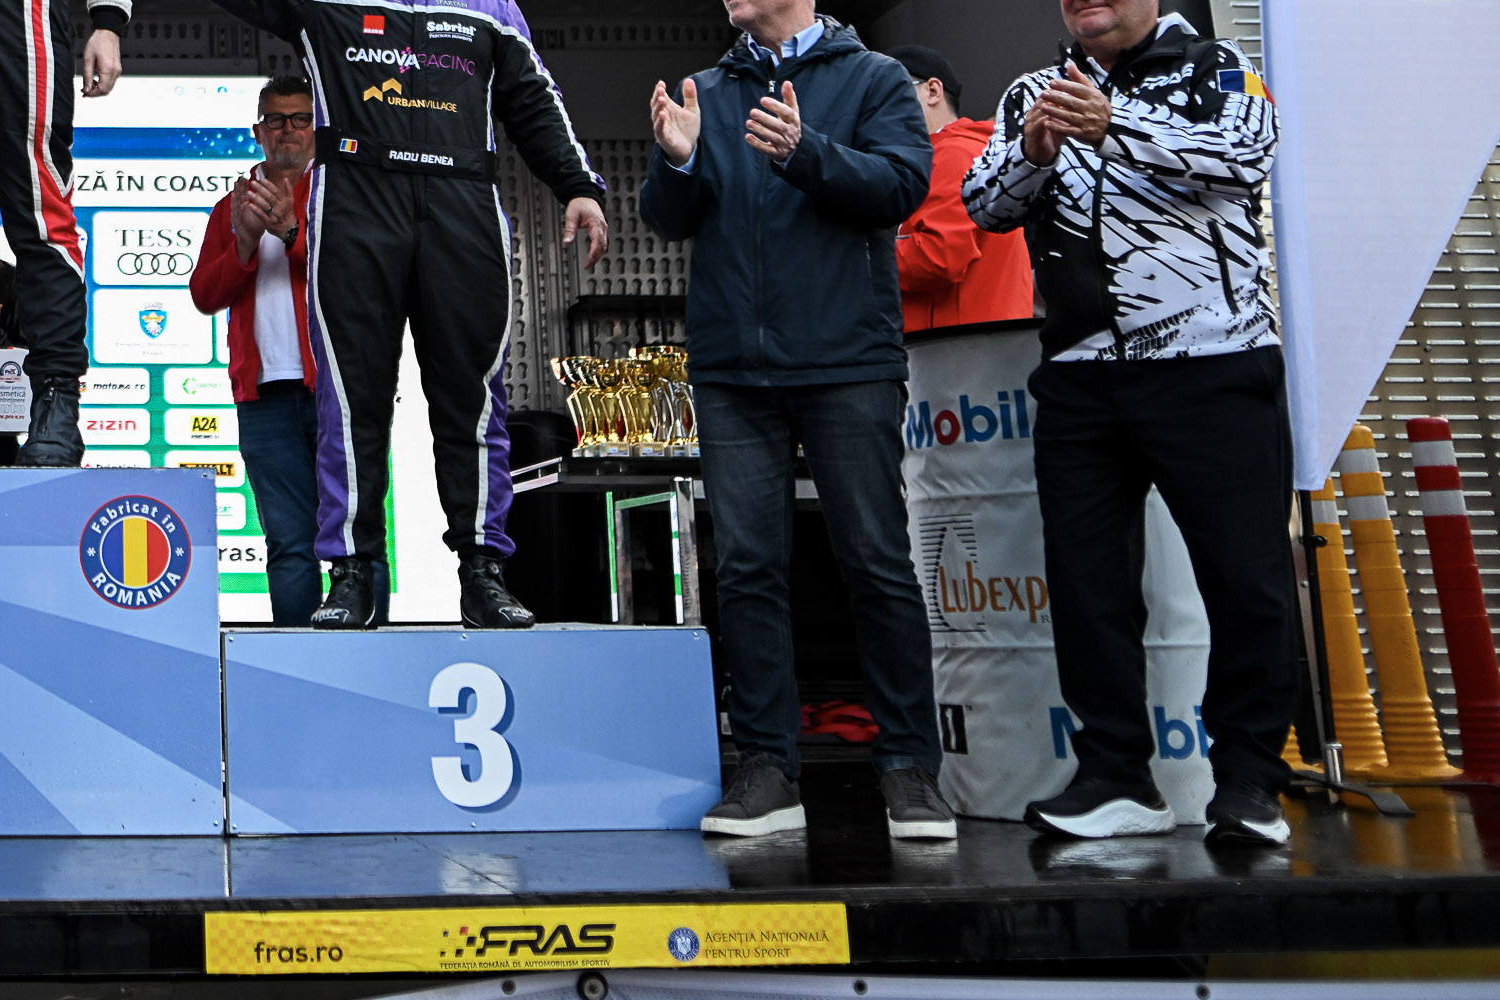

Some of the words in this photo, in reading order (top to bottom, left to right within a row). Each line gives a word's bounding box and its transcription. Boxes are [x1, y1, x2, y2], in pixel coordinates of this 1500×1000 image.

[389, 150, 419, 162] RADU
[116, 170, 144, 192] ÎN
[153, 170, 246, 192] COAST
[115, 229, 192, 248] TESS
[192, 416, 217, 431] A24
[905, 389, 1031, 451] Mobil
[91, 500, 159, 534] Fabricat
[161, 514, 177, 533] în
[91, 571, 182, 606] ROMANIA
[428, 661, 518, 810] 3
[476, 923, 616, 957] FRAS
[704, 930, 757, 944] AGENȚIA
[760, 930, 830, 944] NAȚIONALĂ
[254, 941, 344, 964] fras.ro
[512, 961, 522, 969] DE
[524, 959, 579, 968] AUTOMOBILISM
[581, 959, 611, 967] SPORTIV
